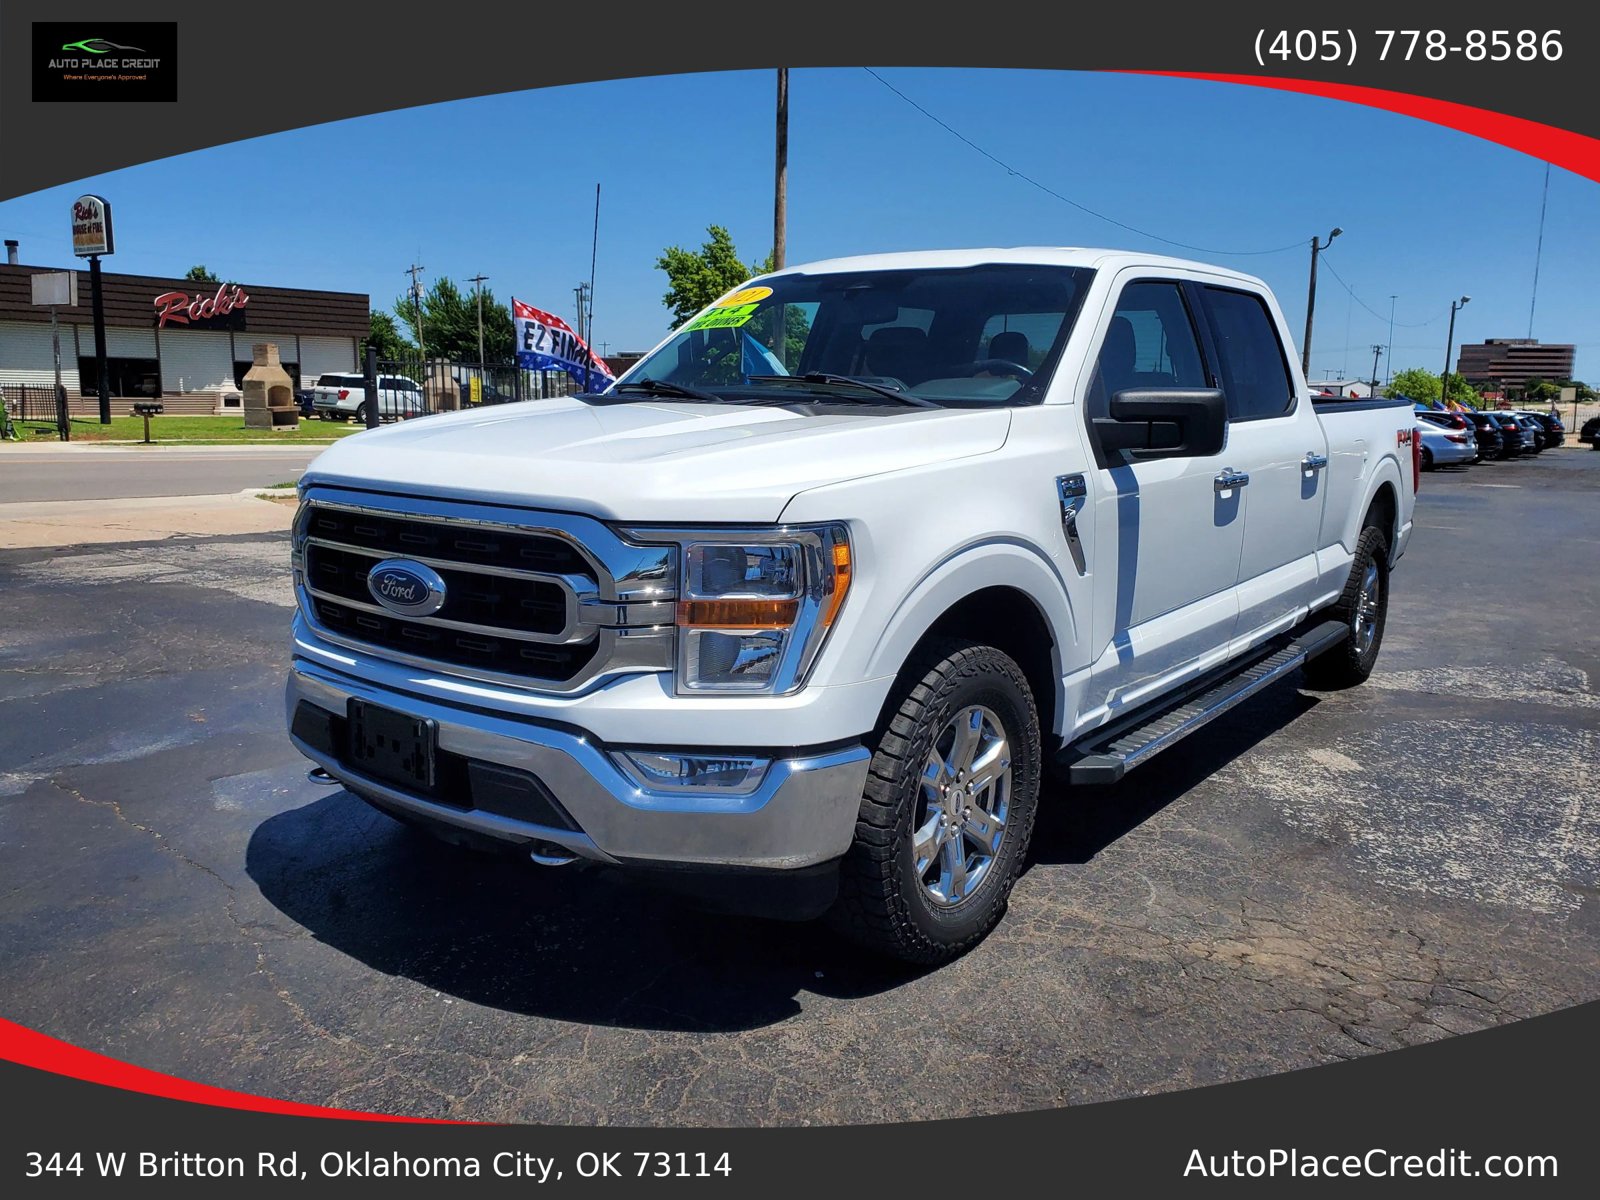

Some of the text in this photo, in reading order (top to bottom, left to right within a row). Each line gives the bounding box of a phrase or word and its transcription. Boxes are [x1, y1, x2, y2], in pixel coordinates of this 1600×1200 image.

[73, 201, 99, 222] Rick's
[154, 283, 250, 328] Rick's
[523, 321, 548, 351] EZ
[380, 573, 416, 600] Ford
